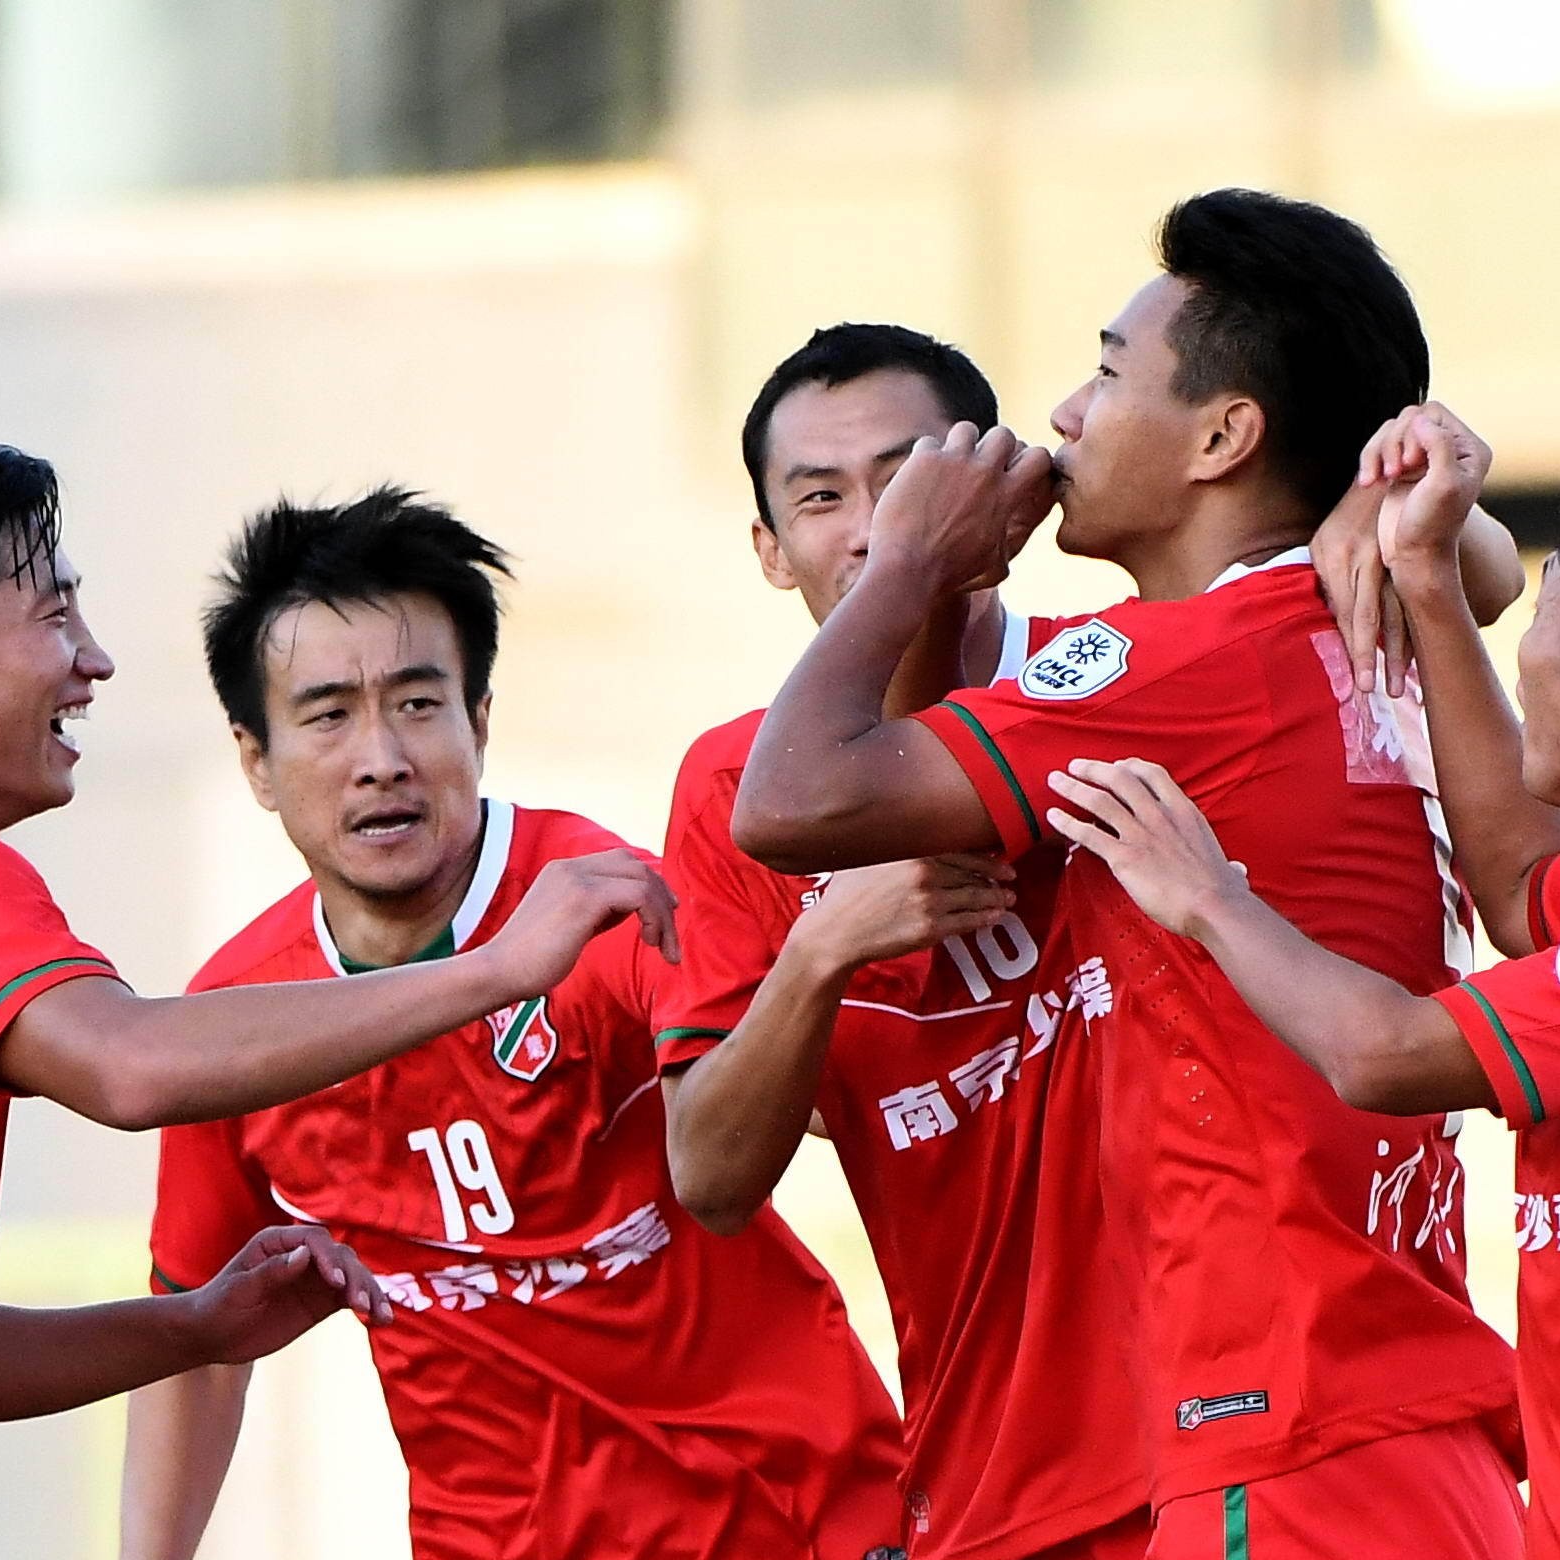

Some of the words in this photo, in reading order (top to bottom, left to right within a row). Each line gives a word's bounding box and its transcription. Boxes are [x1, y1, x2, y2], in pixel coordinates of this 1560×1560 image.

[1035, 658, 1085, 687] CMCL
[943, 911, 1039, 1003] 10
[407, 1119, 514, 1242] 19
